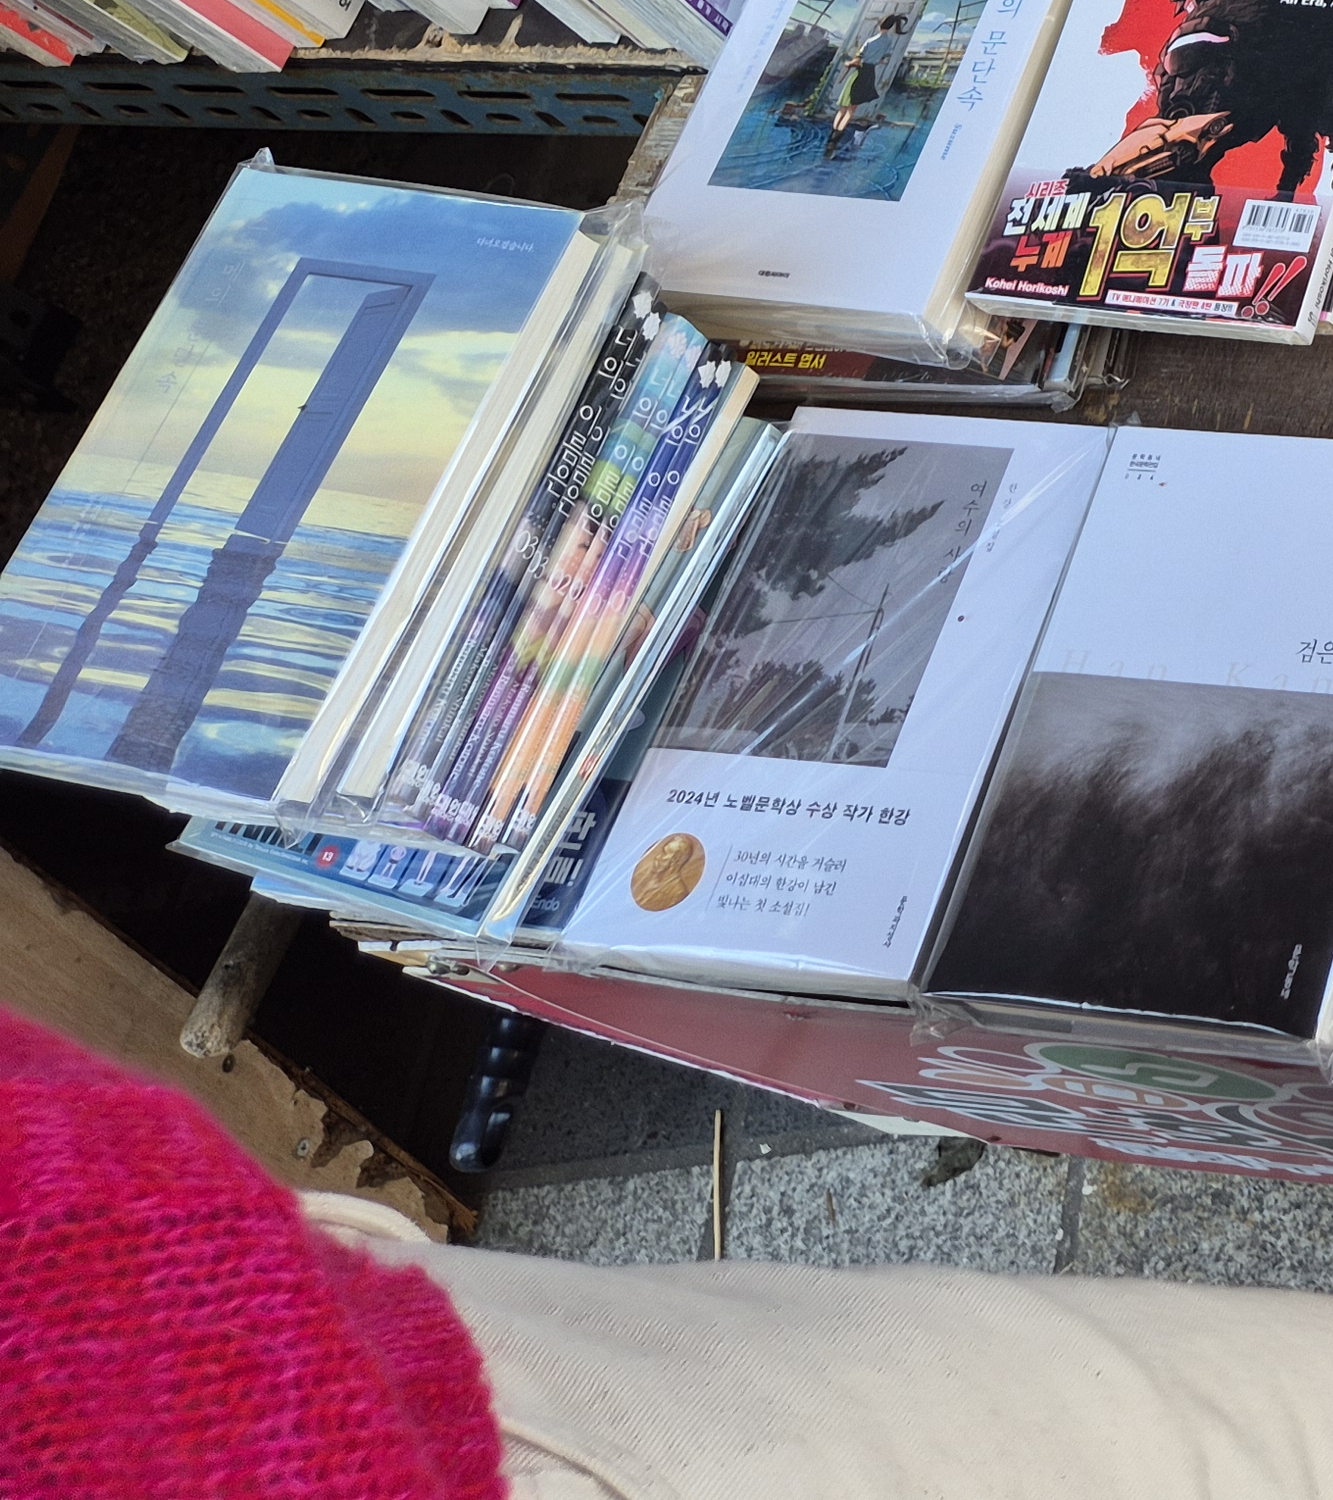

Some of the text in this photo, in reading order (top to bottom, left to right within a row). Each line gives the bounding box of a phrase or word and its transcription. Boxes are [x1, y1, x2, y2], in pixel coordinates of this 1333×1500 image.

[956, 28, 1009, 114] 문단속
[1024, 182, 1067, 199] 시리즈
[1010, 234, 1070, 271] 누계
[985, 277, 1068, 297] Kohei Horikoshi
[744, 350, 826, 369] 일러스트 엽서
[667, 788, 910, 826] 2024년 노벨문학상 수상 작가 한강
[733, 849, 847, 873] 30년의 시간을 거슬러
[725, 872, 837, 896] 이십대의 한강이 남긴
[716, 895, 810, 918] 빛나는 첫 소설집!
